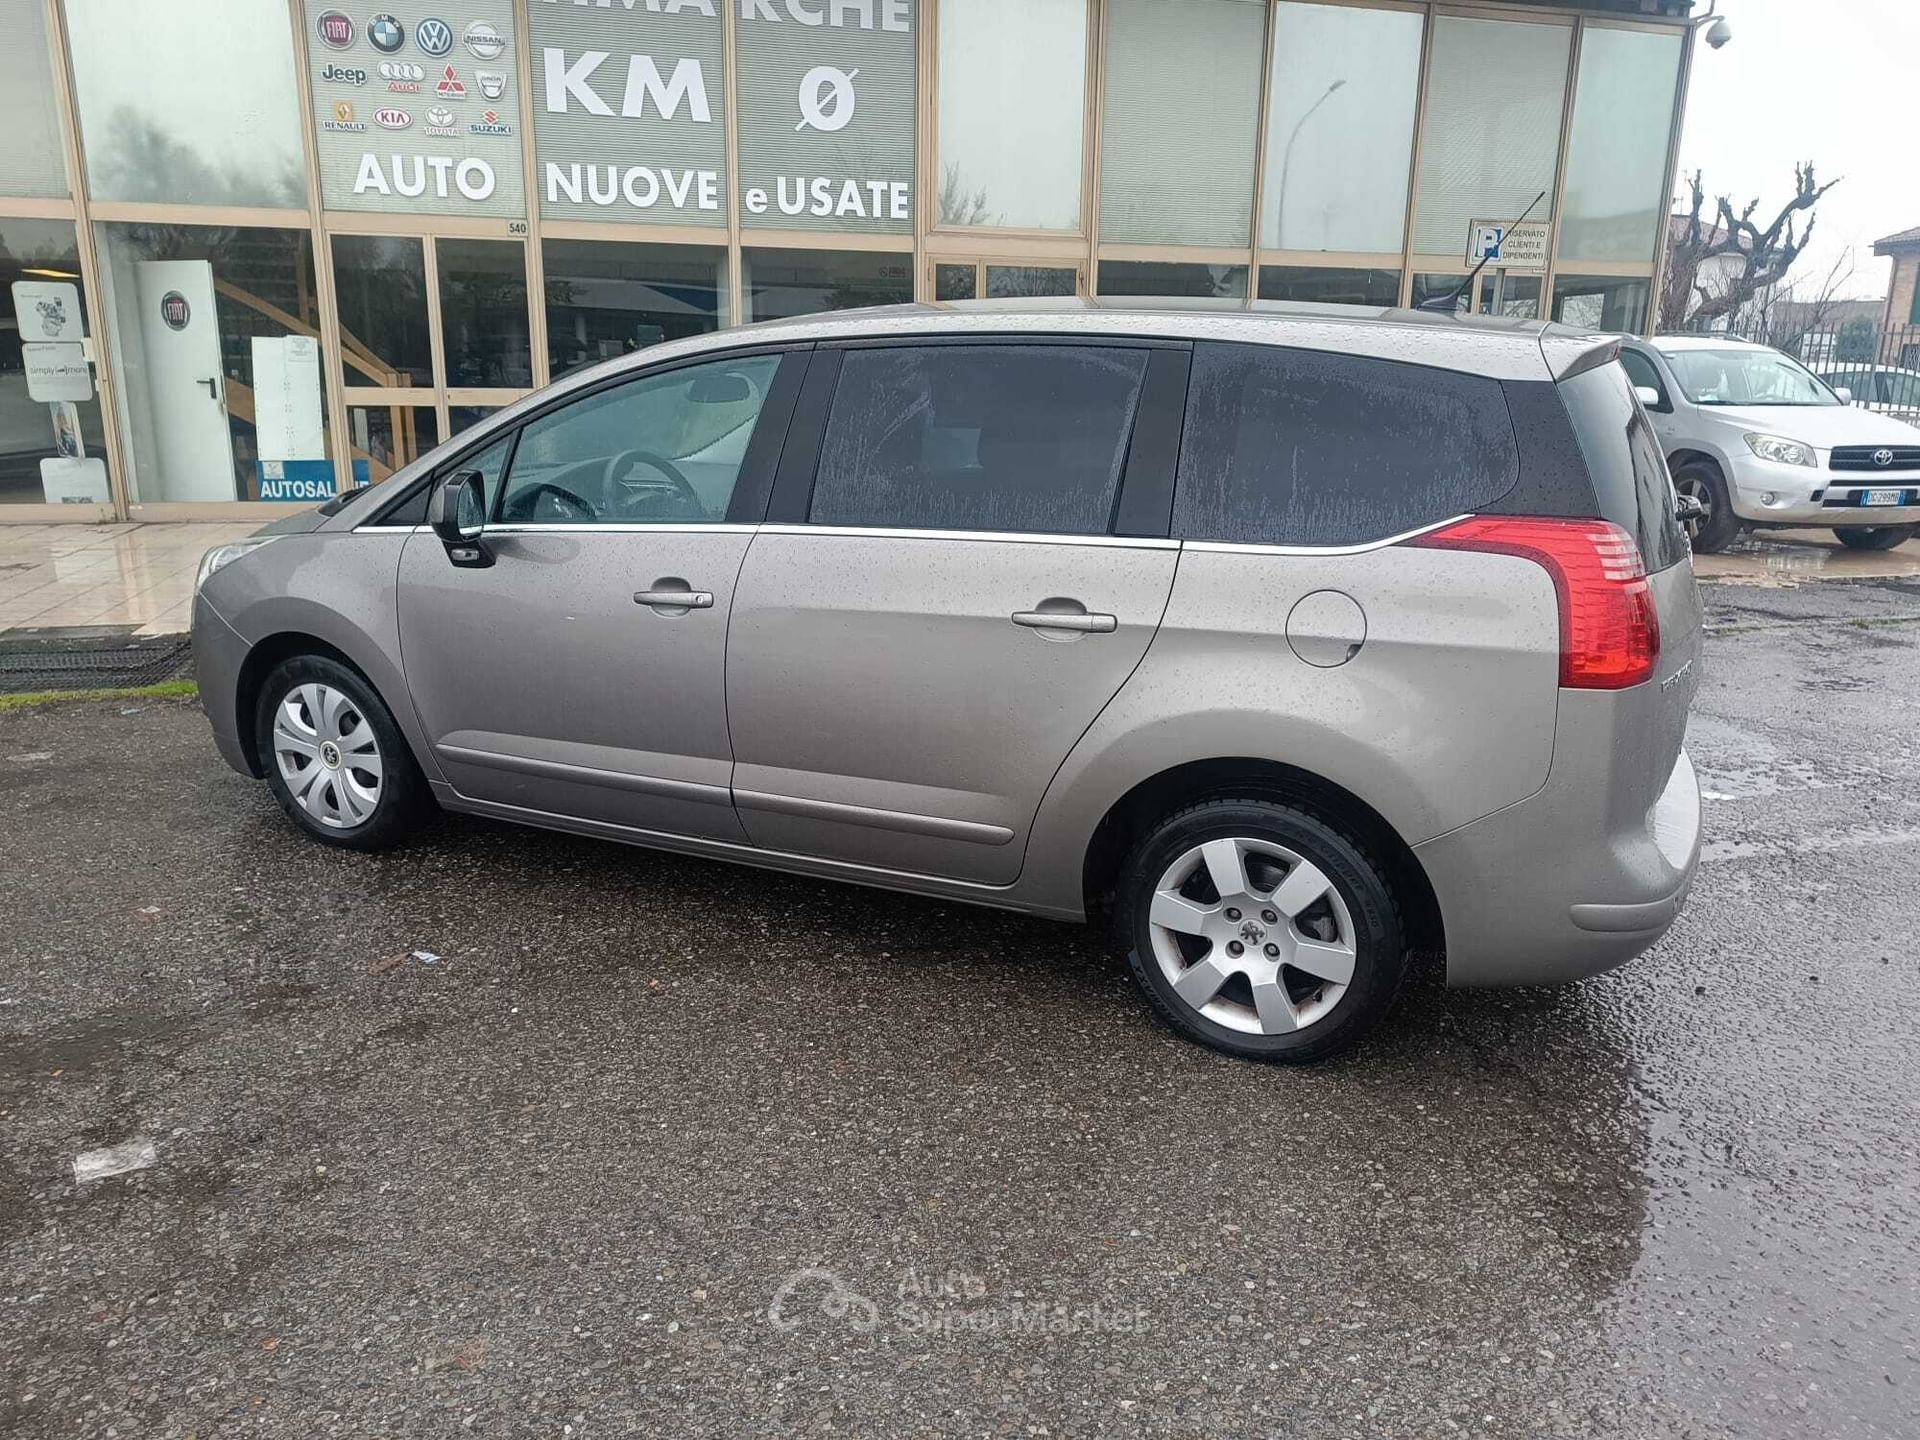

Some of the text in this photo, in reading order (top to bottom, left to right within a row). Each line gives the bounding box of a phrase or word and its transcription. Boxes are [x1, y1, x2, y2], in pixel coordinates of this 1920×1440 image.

[326, 21, 346, 38] FIAT
[466, 34, 502, 43] NISSAN
[322, 64, 366, 84] Jeep
[543, 47, 711, 122] KM
[381, 111, 405, 124] KIA
[324, 121, 366, 130] RENAULT
[470, 125, 512, 133] SUZUKI
[353, 154, 909, 219] AUTO NUOVE e USATE
[509, 222, 526, 233] 540
[167, 303, 184, 321] FIAT
